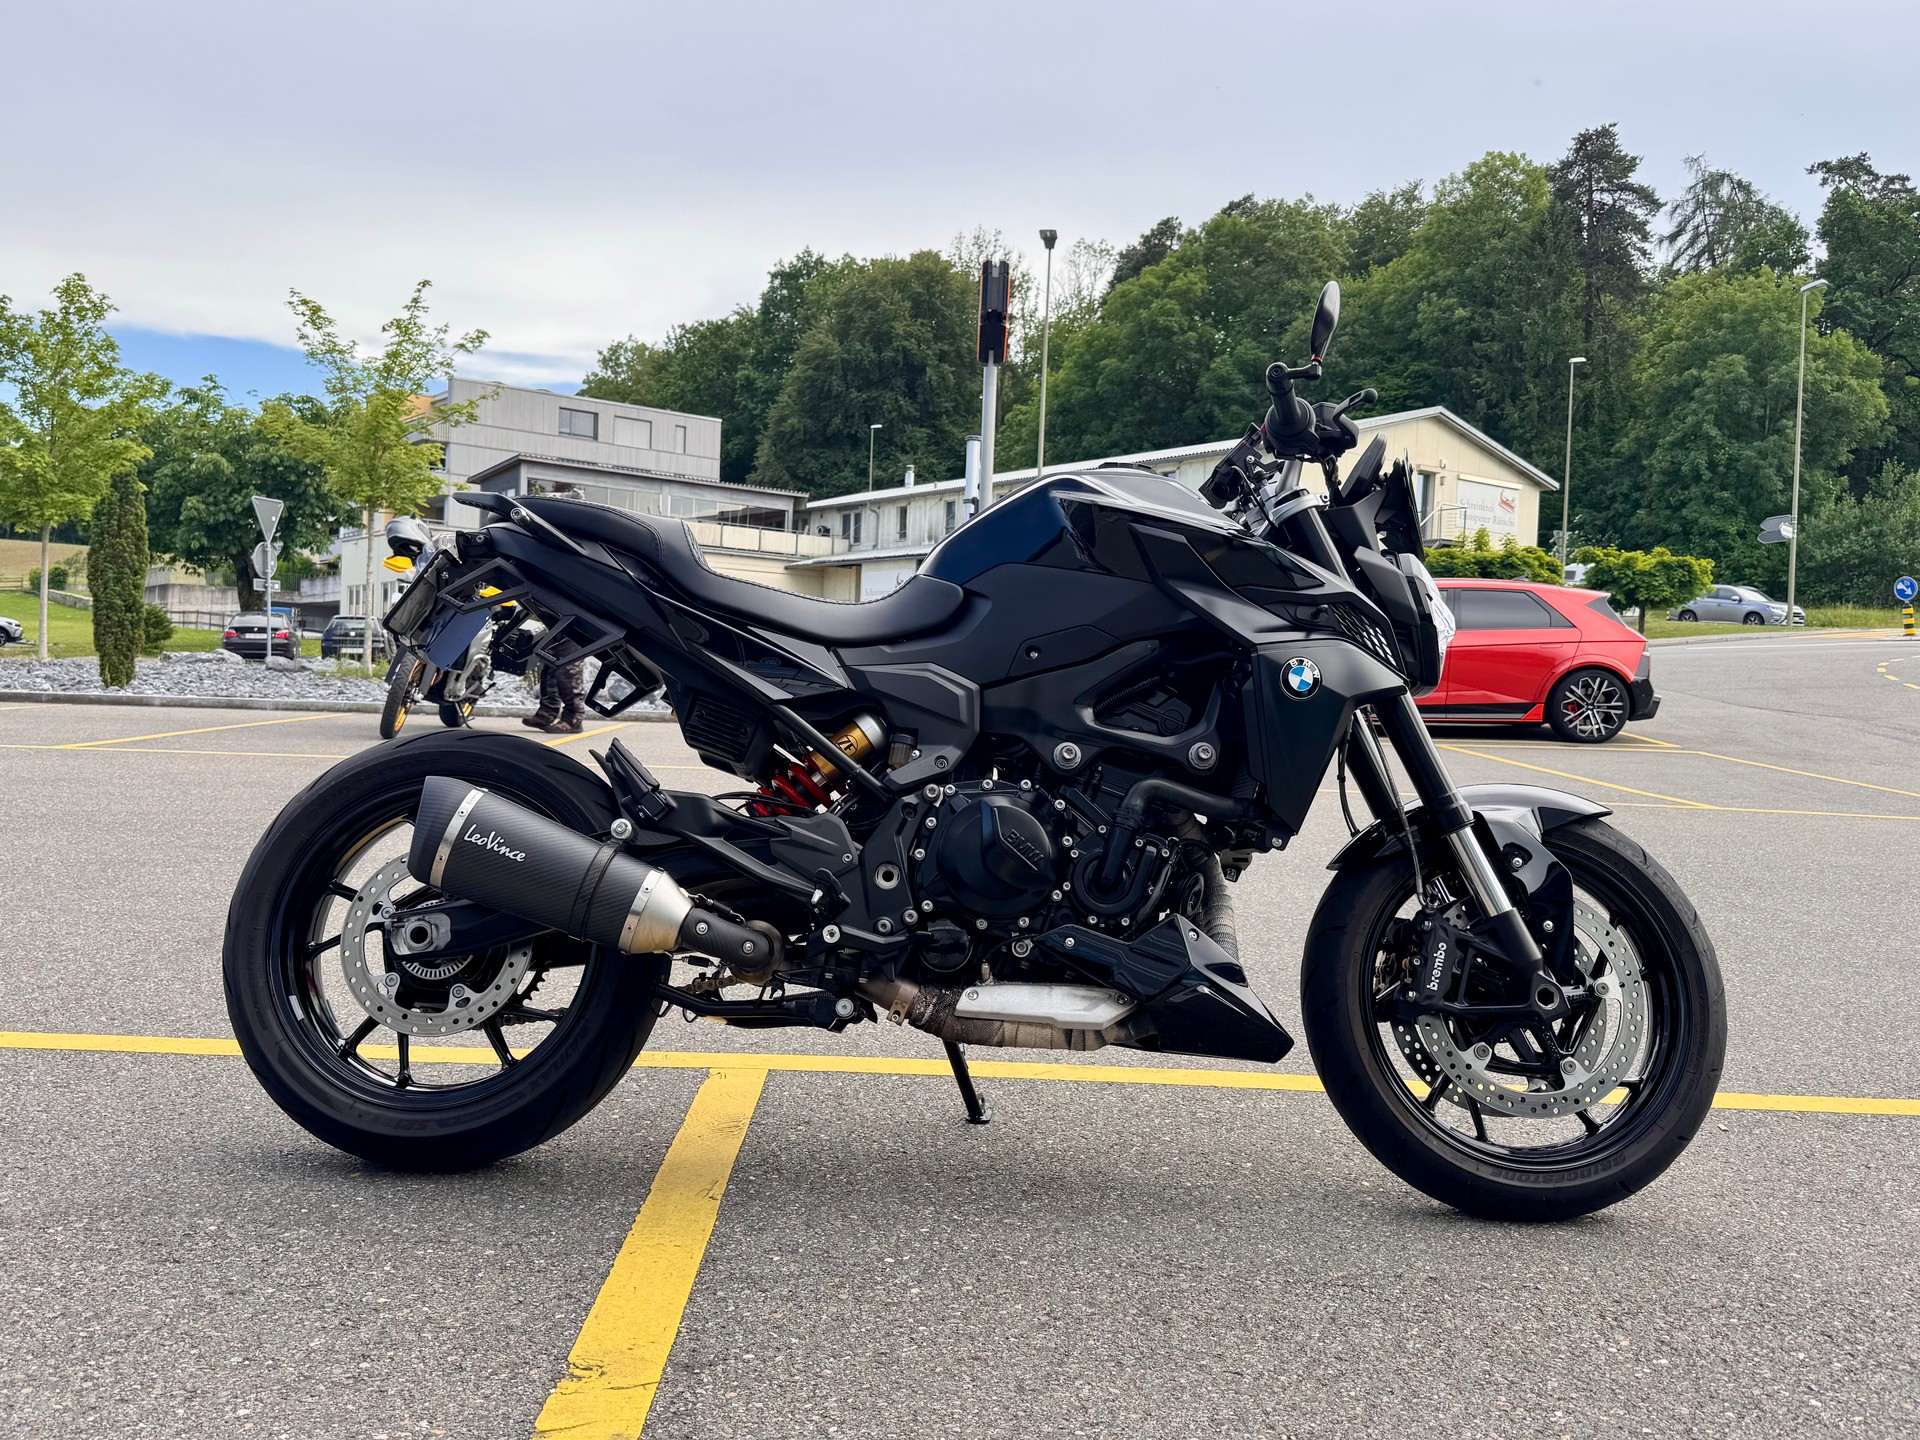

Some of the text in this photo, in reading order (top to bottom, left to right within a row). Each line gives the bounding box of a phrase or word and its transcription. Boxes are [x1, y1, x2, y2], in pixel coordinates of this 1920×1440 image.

[1290, 658, 1320, 678] BMW
[836, 735, 858, 753] ZF
[463, 823, 527, 862] LeoVince
[1004, 828, 1045, 863] BMW
[1426, 942, 1447, 991] brembo
[1489, 1153, 1627, 1184] BRIDGESTONE
